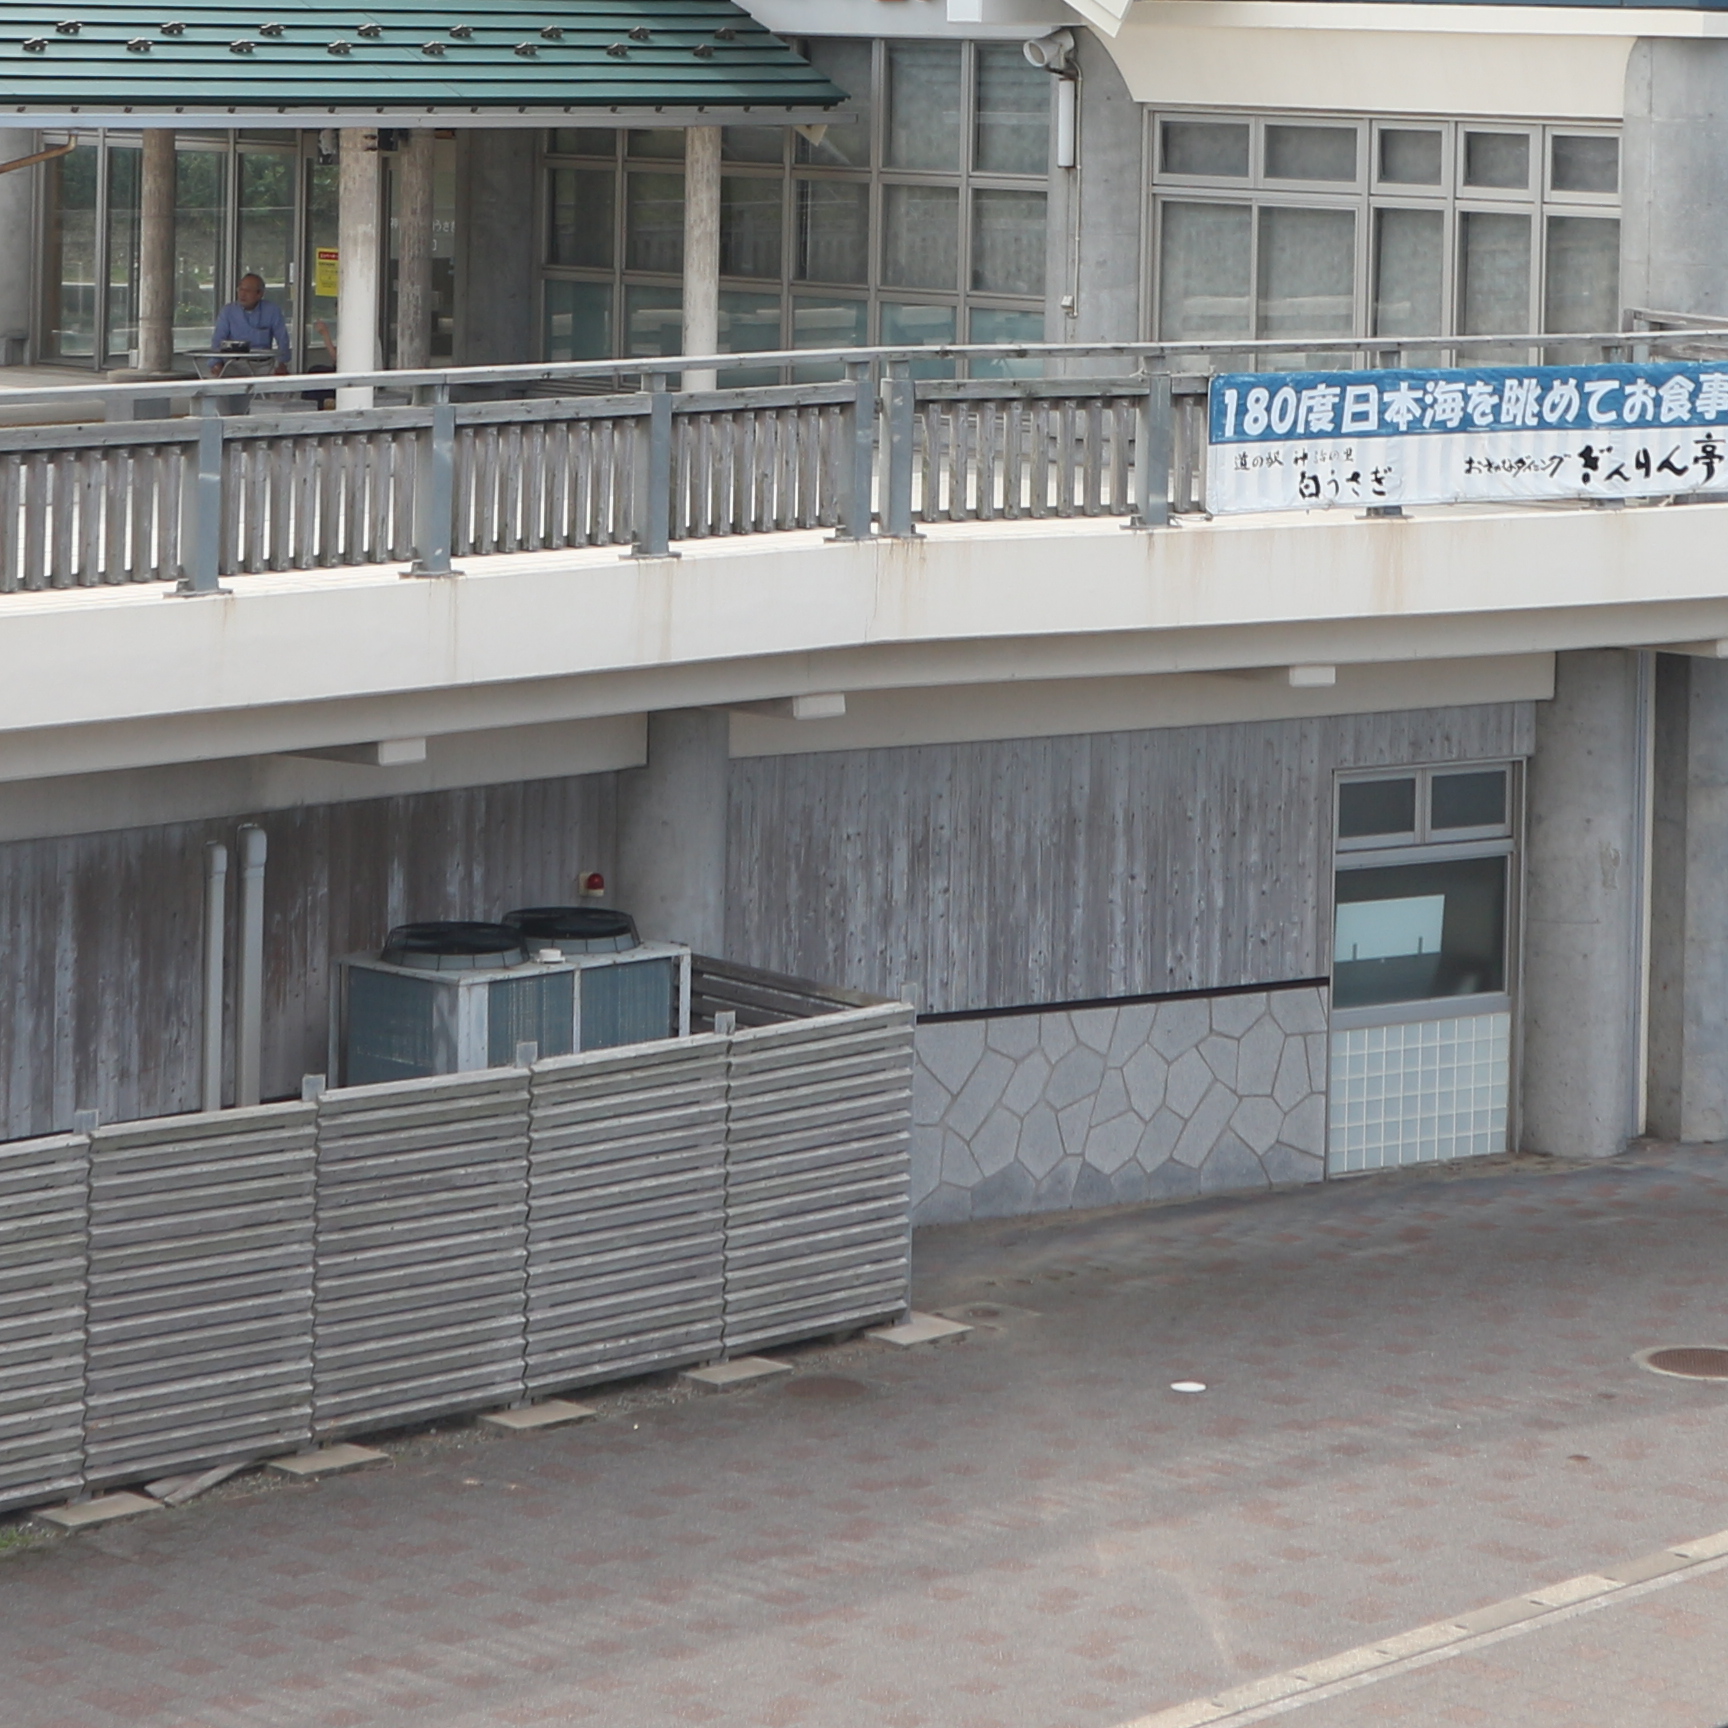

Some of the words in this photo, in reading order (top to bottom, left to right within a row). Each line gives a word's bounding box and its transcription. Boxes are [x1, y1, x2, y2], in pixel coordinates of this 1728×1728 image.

[1577, 432, 1727, 485] ぎんりん亭
[1298, 465, 1393, 500] 白うさぎ
